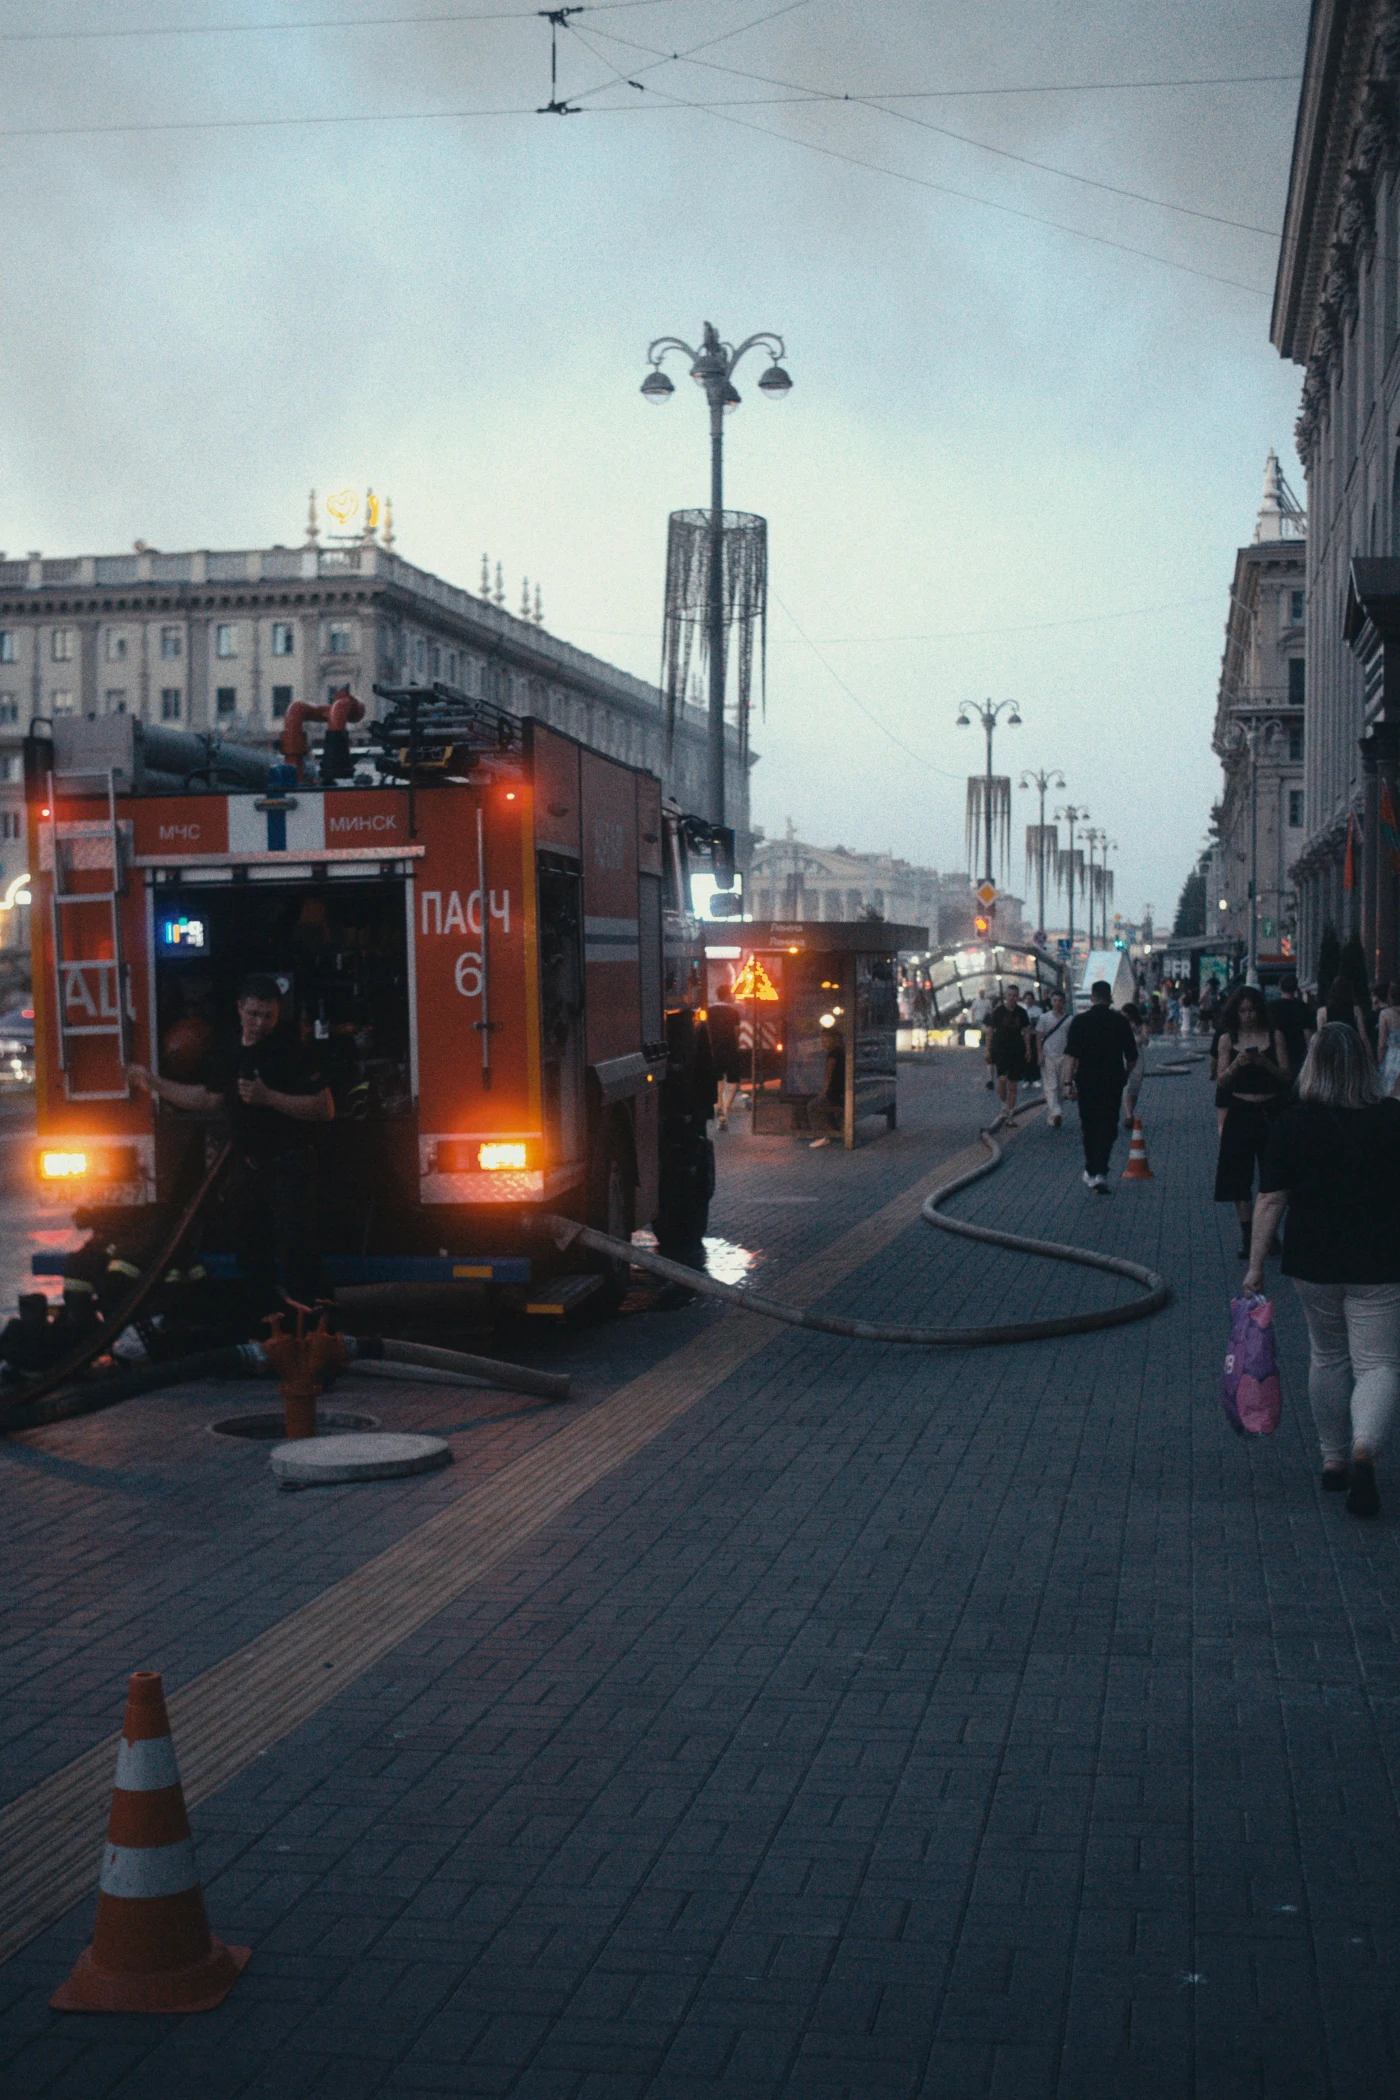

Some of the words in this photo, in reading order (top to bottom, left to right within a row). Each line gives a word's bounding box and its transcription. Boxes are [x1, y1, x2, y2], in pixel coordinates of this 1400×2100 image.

[159, 824, 201, 840] МЧС
[329, 815, 398, 832] МИНСК
[421, 889, 510, 935] ПАСЧ
[454, 952, 483, 997] 6
